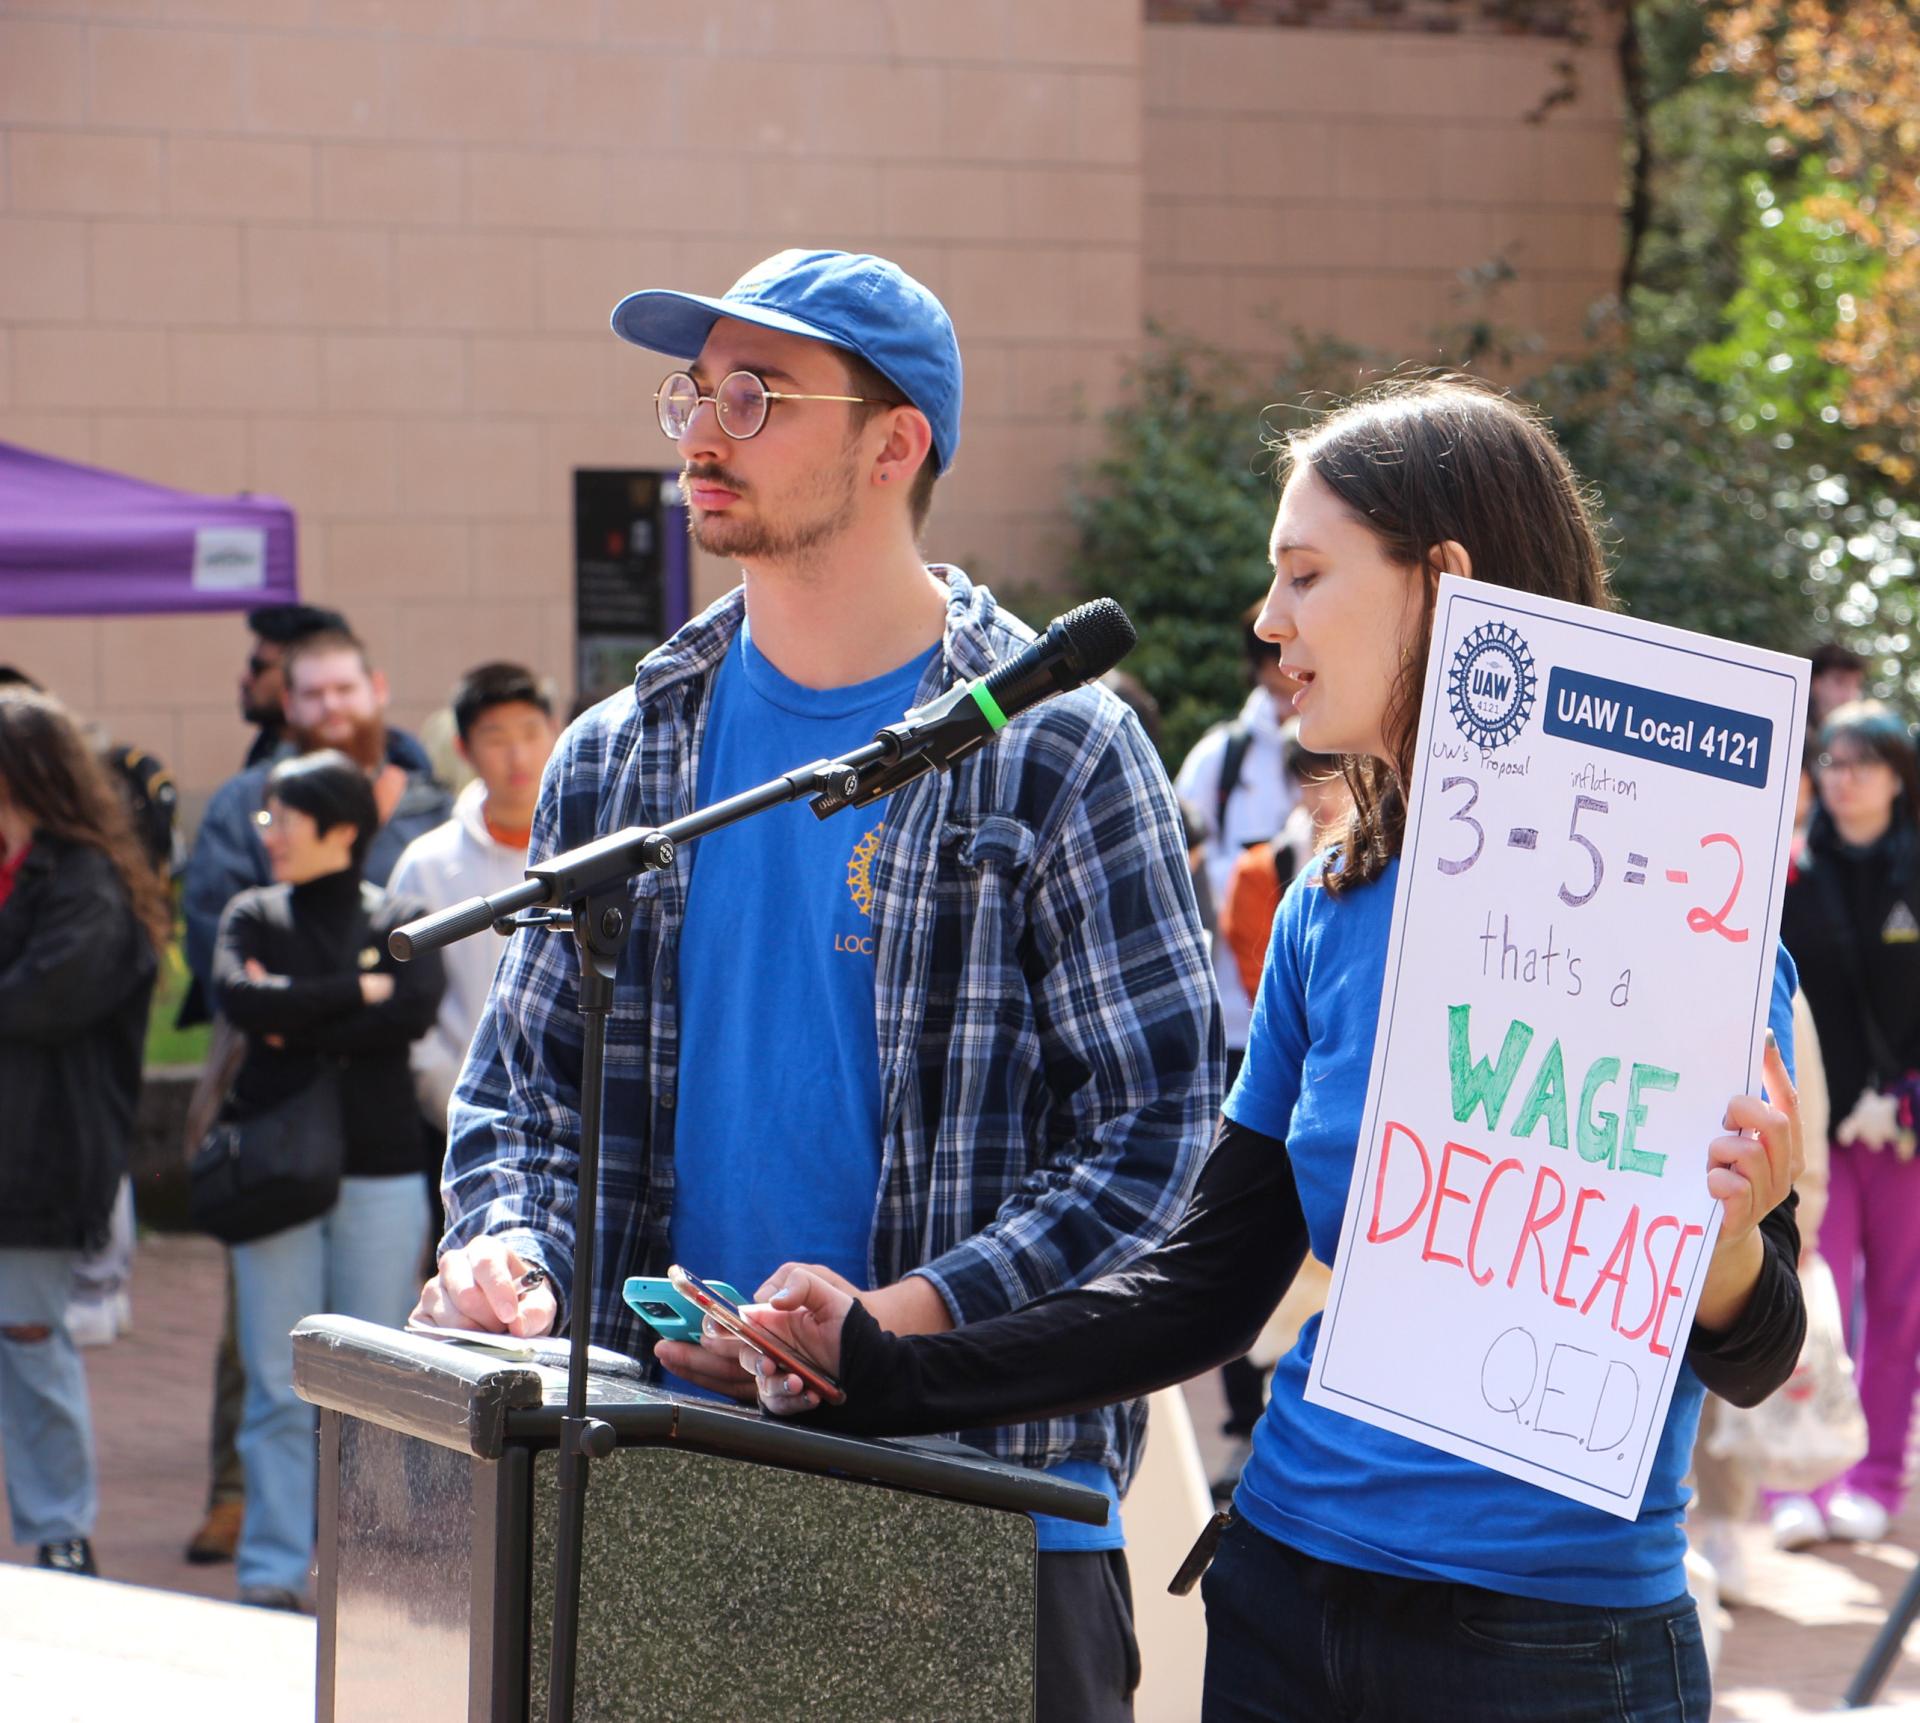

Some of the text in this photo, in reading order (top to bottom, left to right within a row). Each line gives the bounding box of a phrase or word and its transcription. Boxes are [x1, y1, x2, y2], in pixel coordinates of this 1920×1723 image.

[1472, 669, 1511, 701] UAW
[1477, 701, 1499, 714] 4121
[1557, 688, 1619, 733] UAW
[1624, 706, 1694, 753] Local
[1699, 723, 1760, 769] 4121
[1432, 740, 1531, 779] UW's Proposal
[1570, 763, 1637, 800] inflation
[1437, 776, 1485, 875] 3
[1557, 794, 1609, 907] 5
[1479, 910, 1632, 1008] that's a
[1447, 1003, 1680, 1177] WAGE
[1367, 1121, 1703, 1357] DECREASE
[1481, 1326, 1639, 1461] Q.E.D.
